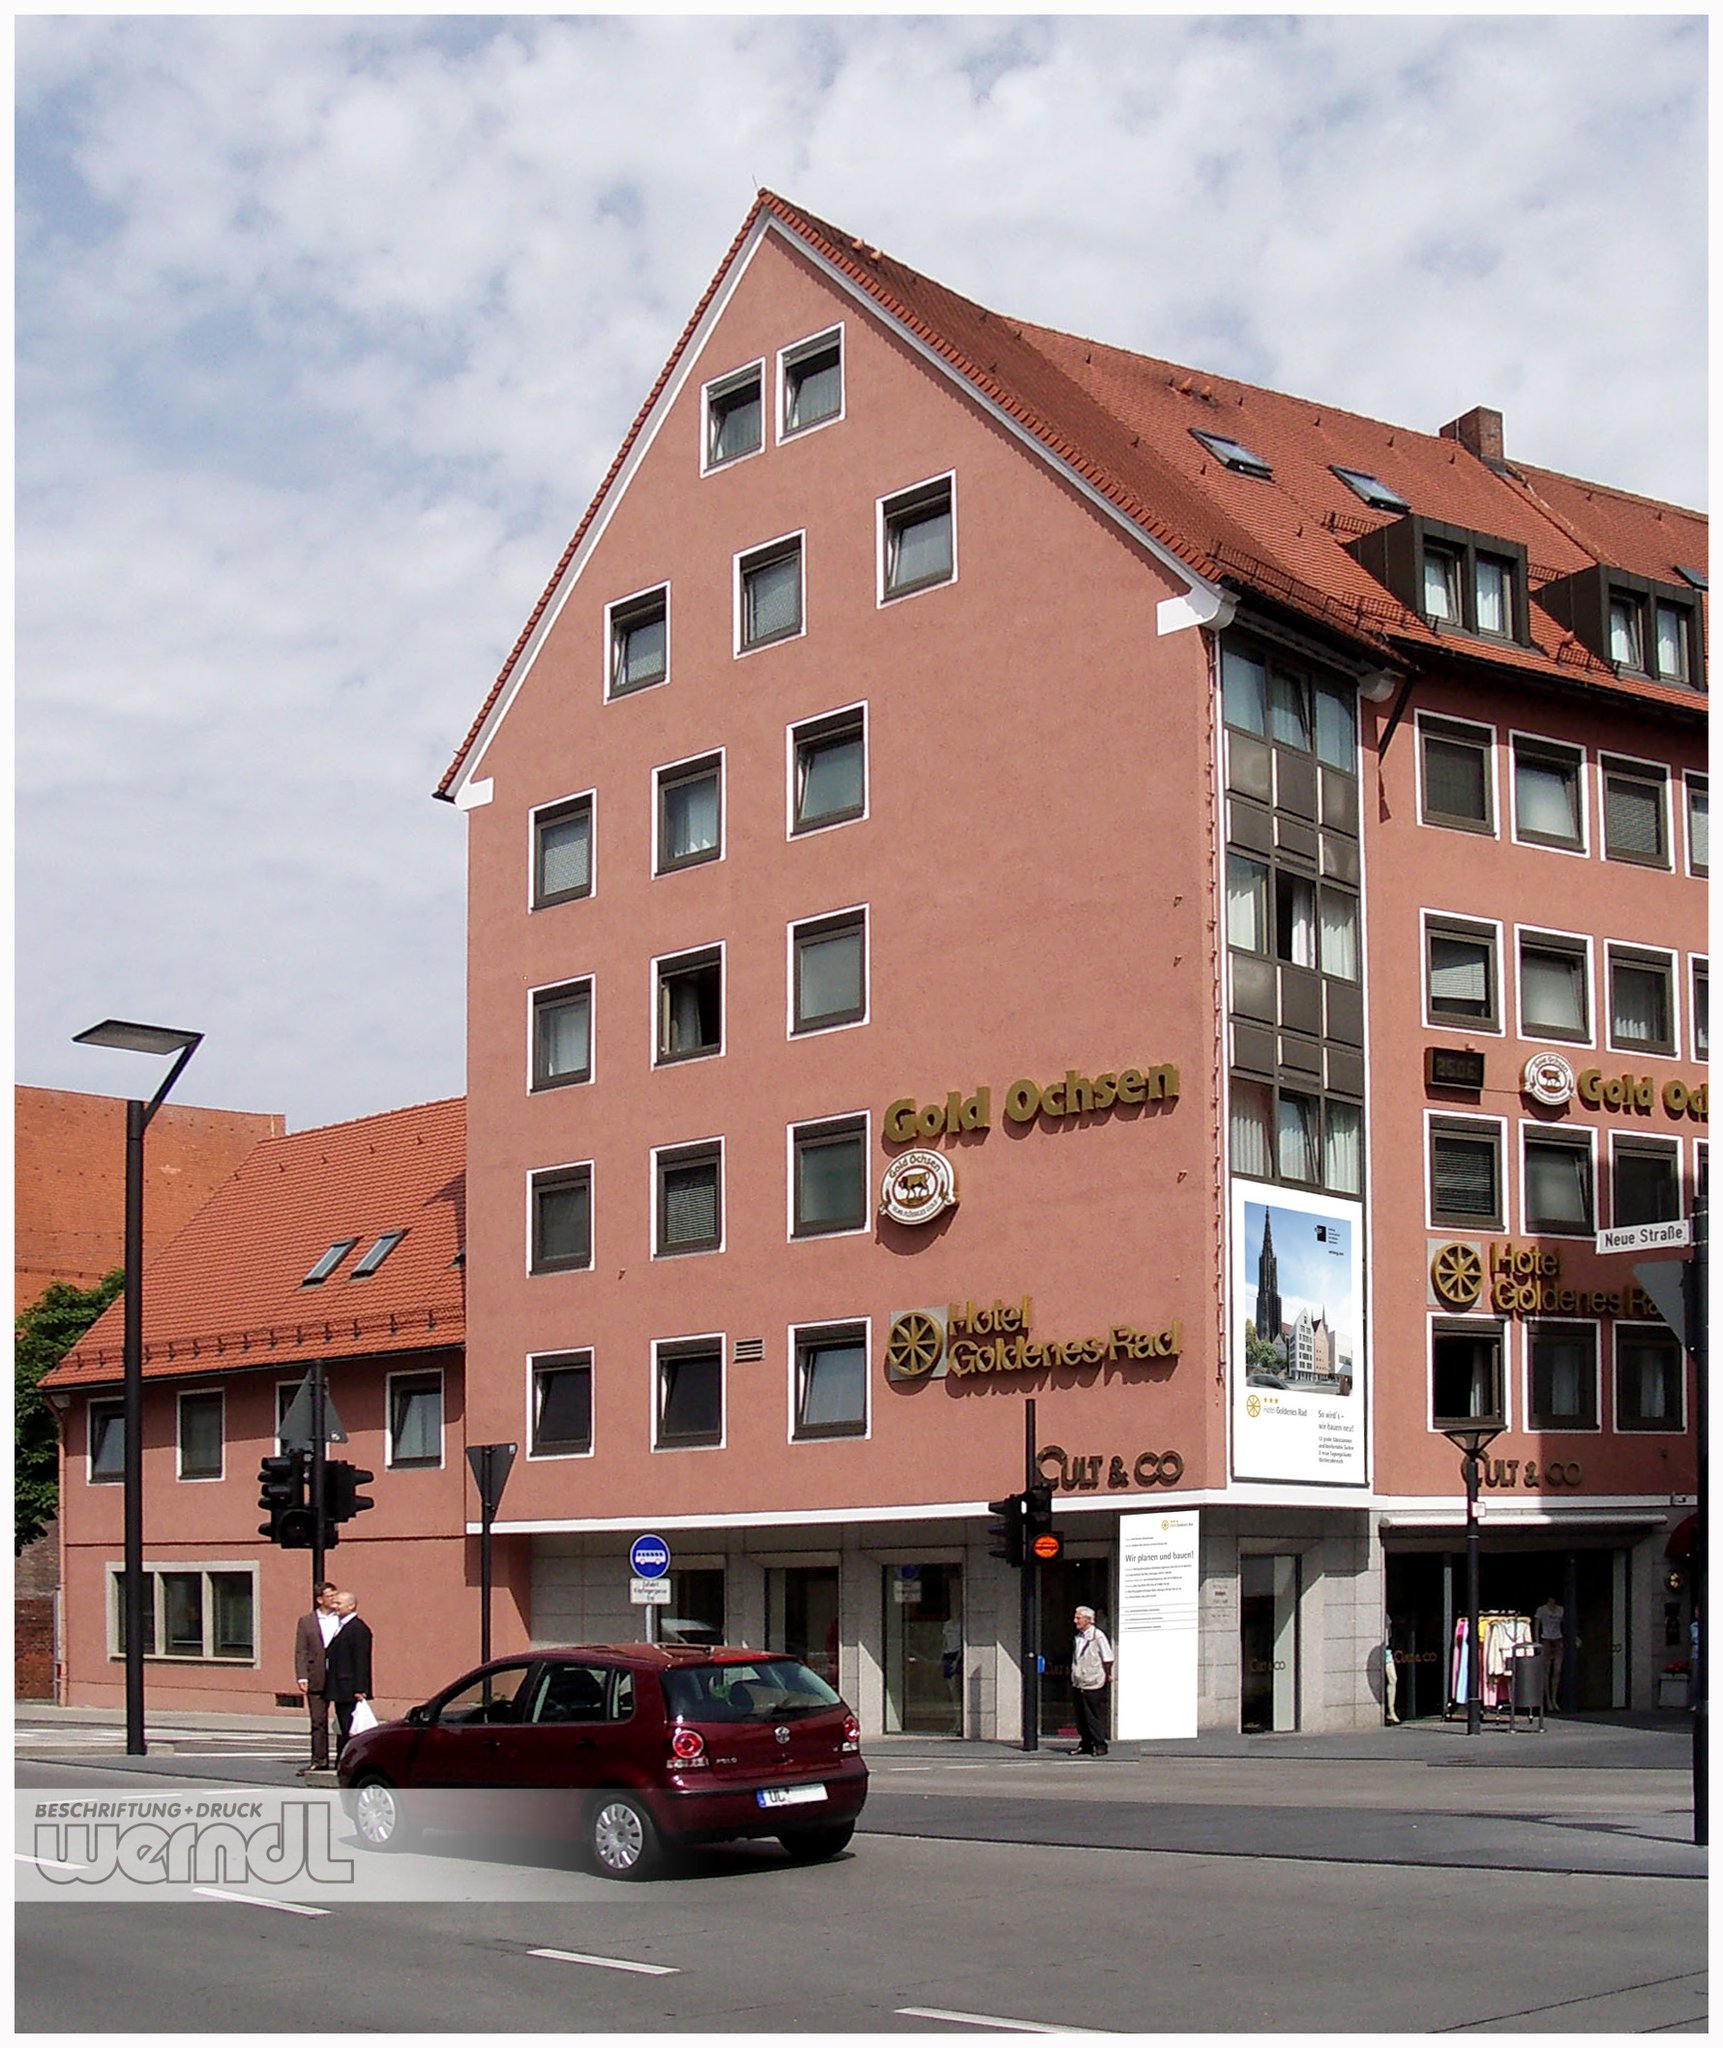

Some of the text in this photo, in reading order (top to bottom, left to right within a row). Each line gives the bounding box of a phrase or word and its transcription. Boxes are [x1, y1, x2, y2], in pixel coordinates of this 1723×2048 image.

[883, 1063, 1179, 1143] Gold Ochsen
[1577, 1068, 1654, 1107] Gold
[889, 1154, 942, 1179] Gold Ochsen
[1605, 1225, 1683, 1248] Neue Straße
[1490, 1242, 1560, 1276] Hotel
[949, 1294, 1032, 1335] Hotel
[1491, 1277, 1621, 1315] Goldenes
[949, 1320, 1183, 1378] Goldenes Rad
[1037, 1445, 1184, 1491] CULT & CO
[1524, 1461, 1540, 1488] &
[1545, 1462, 1583, 1487] CO
[1125, 1549, 1194, 1564] Wir planen und bauen!
